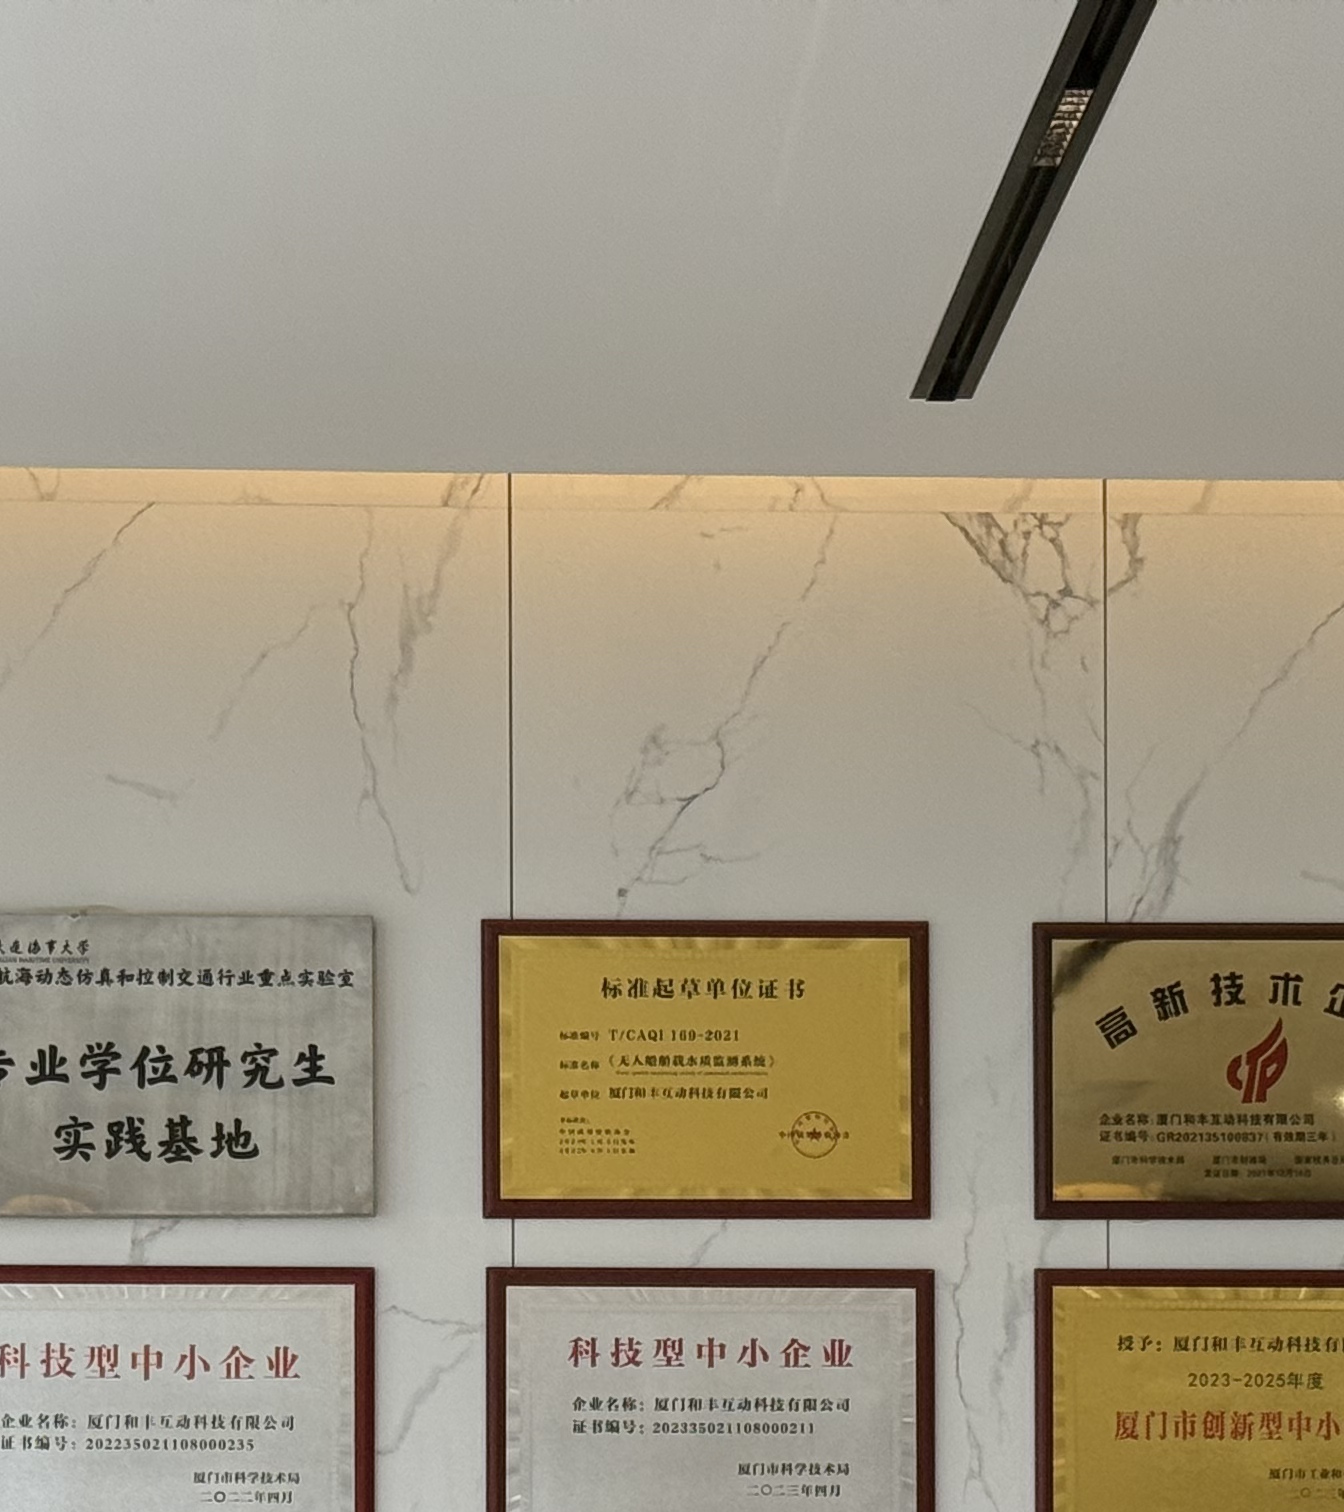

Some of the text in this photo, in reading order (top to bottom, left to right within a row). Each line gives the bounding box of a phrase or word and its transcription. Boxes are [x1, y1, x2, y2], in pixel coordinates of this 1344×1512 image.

[601, 977, 807, 1000] 标准起草单位证书
[53, 1114, 260, 1163] 实践基地
[568, 1336, 855, 1369] 科技型中小企业
[1187, 1372, 1324, 1391] 2023-2025年度
[193, 1471, 301, 1486] 厦门市科学技术局
[737, 1461, 850, 1477] 厦门市科学技术局
